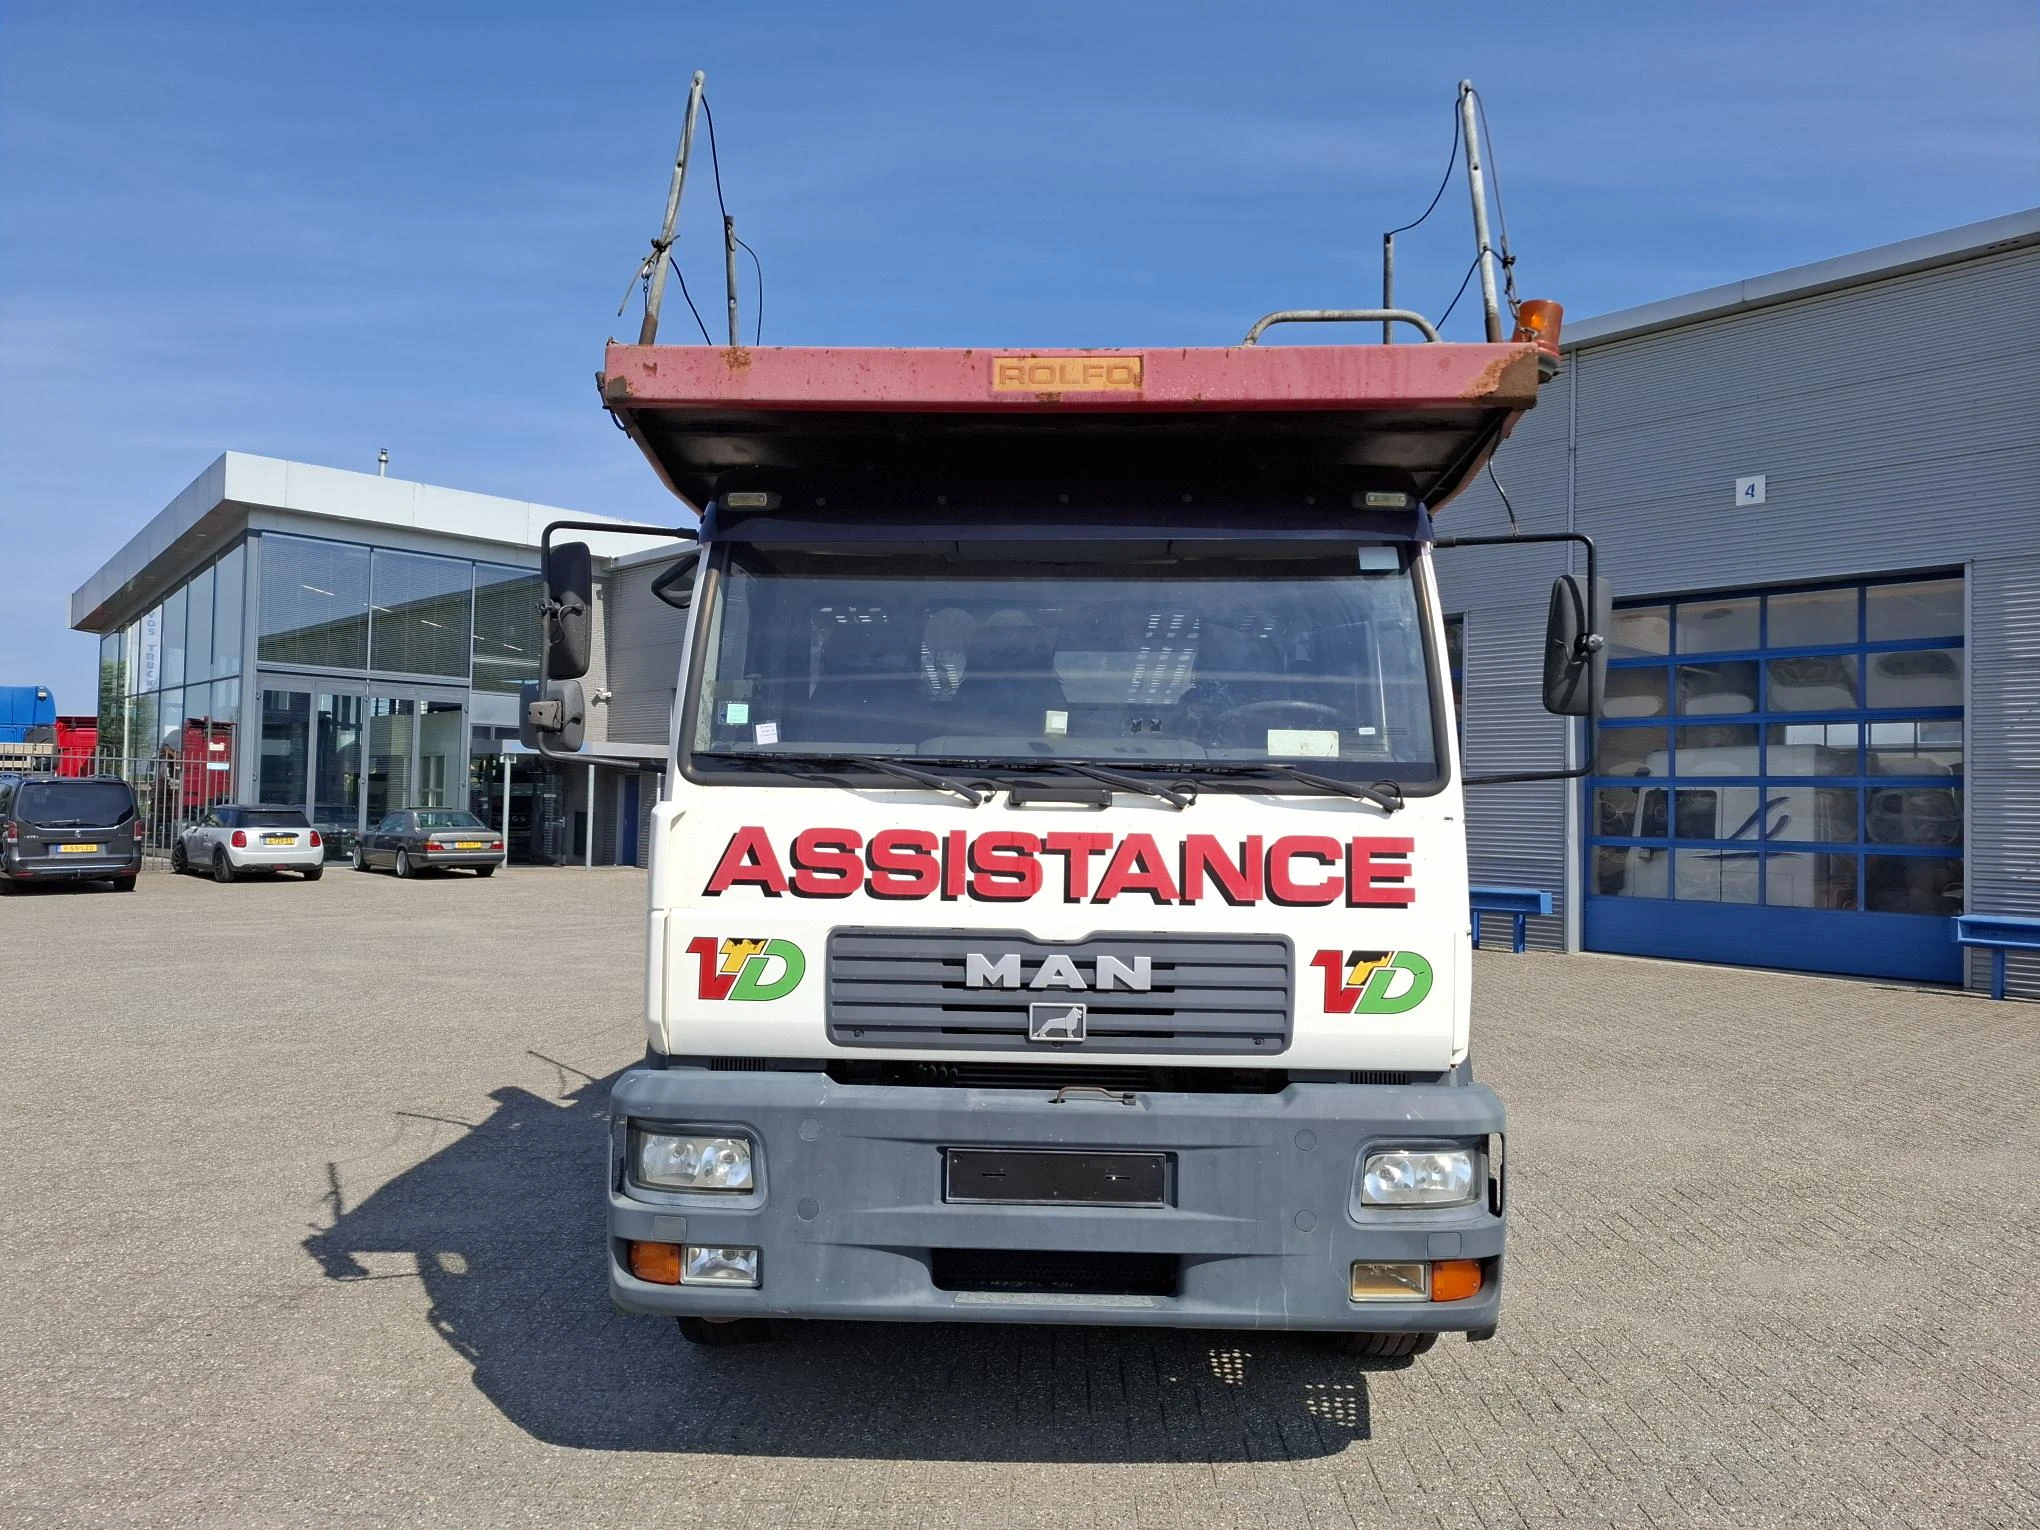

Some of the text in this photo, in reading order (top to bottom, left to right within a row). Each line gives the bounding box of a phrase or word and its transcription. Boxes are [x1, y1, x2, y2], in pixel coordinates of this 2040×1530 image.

[999, 363, 1134, 385] ROLFO
[1744, 483, 1755, 498] 4
[701, 826, 1416, 909] ASSISTANCE
[966, 953, 1152, 991] MAN
